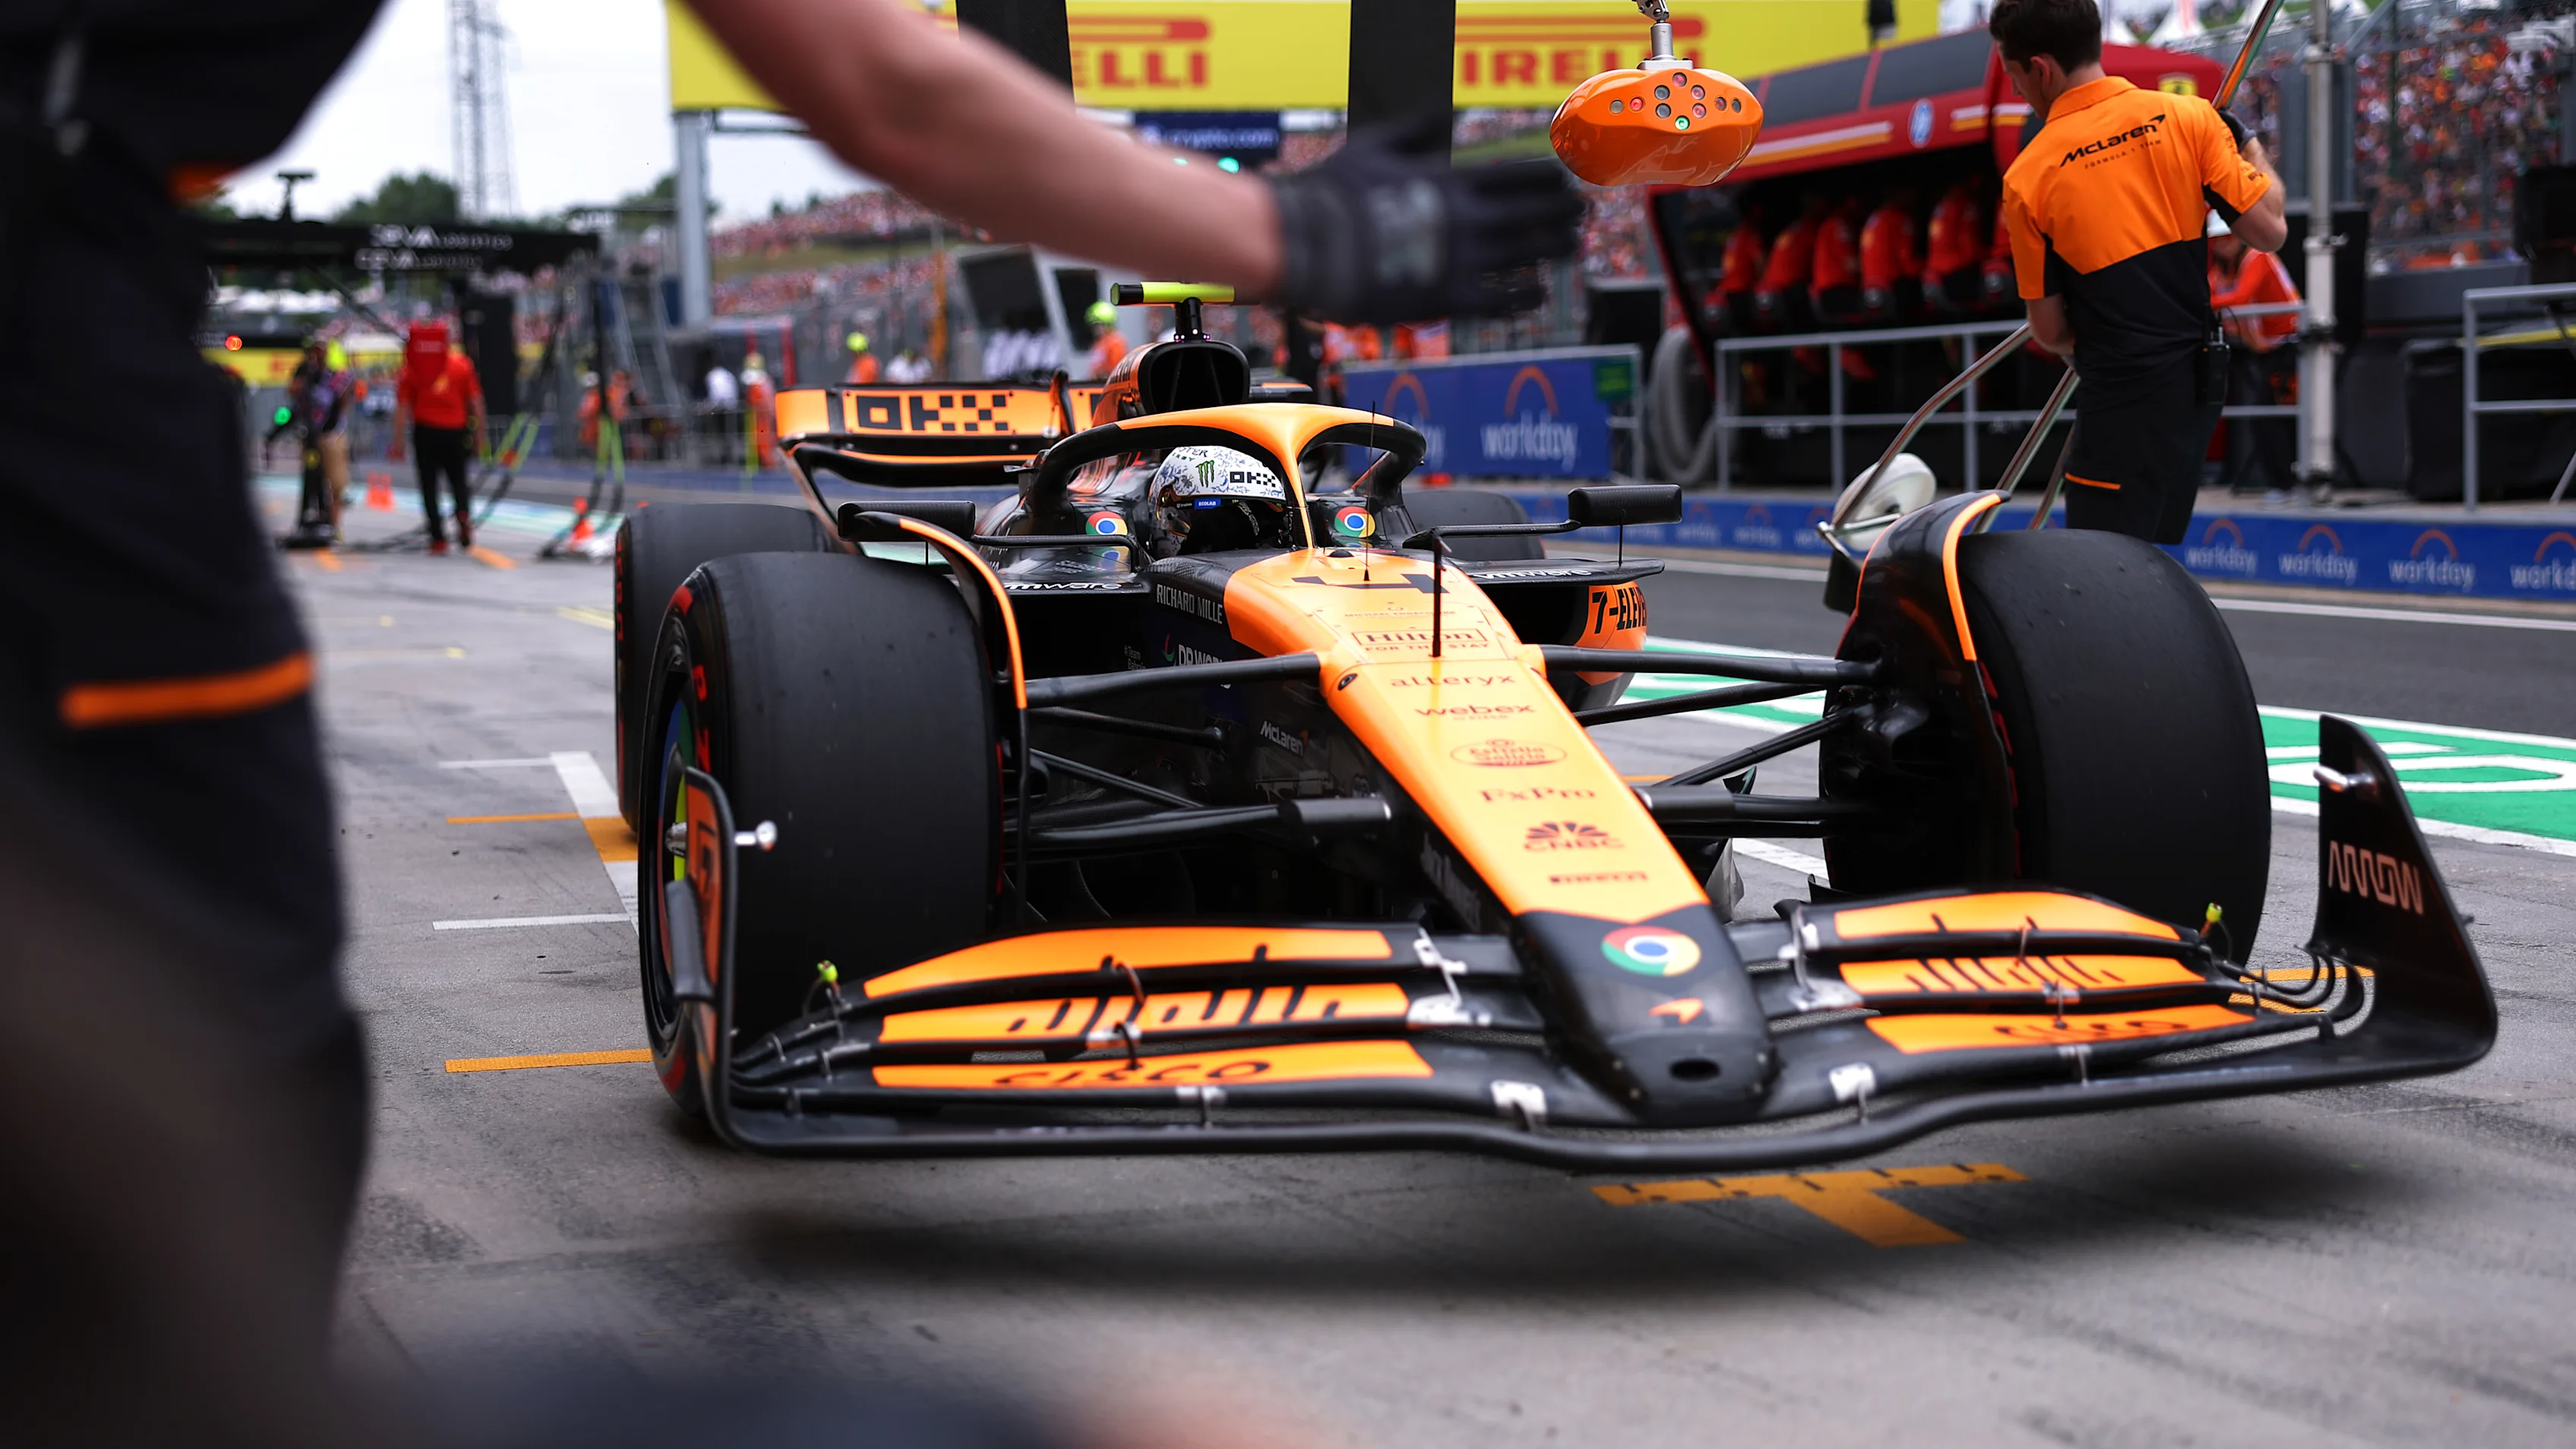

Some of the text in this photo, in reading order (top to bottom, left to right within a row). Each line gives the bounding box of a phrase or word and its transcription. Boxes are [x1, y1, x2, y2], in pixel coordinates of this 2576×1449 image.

[2060, 123, 2158, 168] McLaren
[2085, 150, 2126, 169] FORMULA
[1482, 410, 1577, 473] workday
[2185, 542, 2259, 578] workday
[2278, 548, 2359, 586] workday
[2388, 553, 2476, 592] workday
[2509, 557, 2576, 590] workd
[1004, 582, 1122, 590] mware
[1156, 583, 1223, 624] RICHARD MILLE
[1366, 633, 1473, 642] Hilton
[1391, 674, 1516, 688] alteryx
[1414, 704, 1535, 716] webex
[1260, 721, 1304, 756] McLaren
[1480, 786, 1596, 802] FxPro
[1523, 837, 1625, 852] CNBC
[992, 1060, 1273, 1087] CISCO
